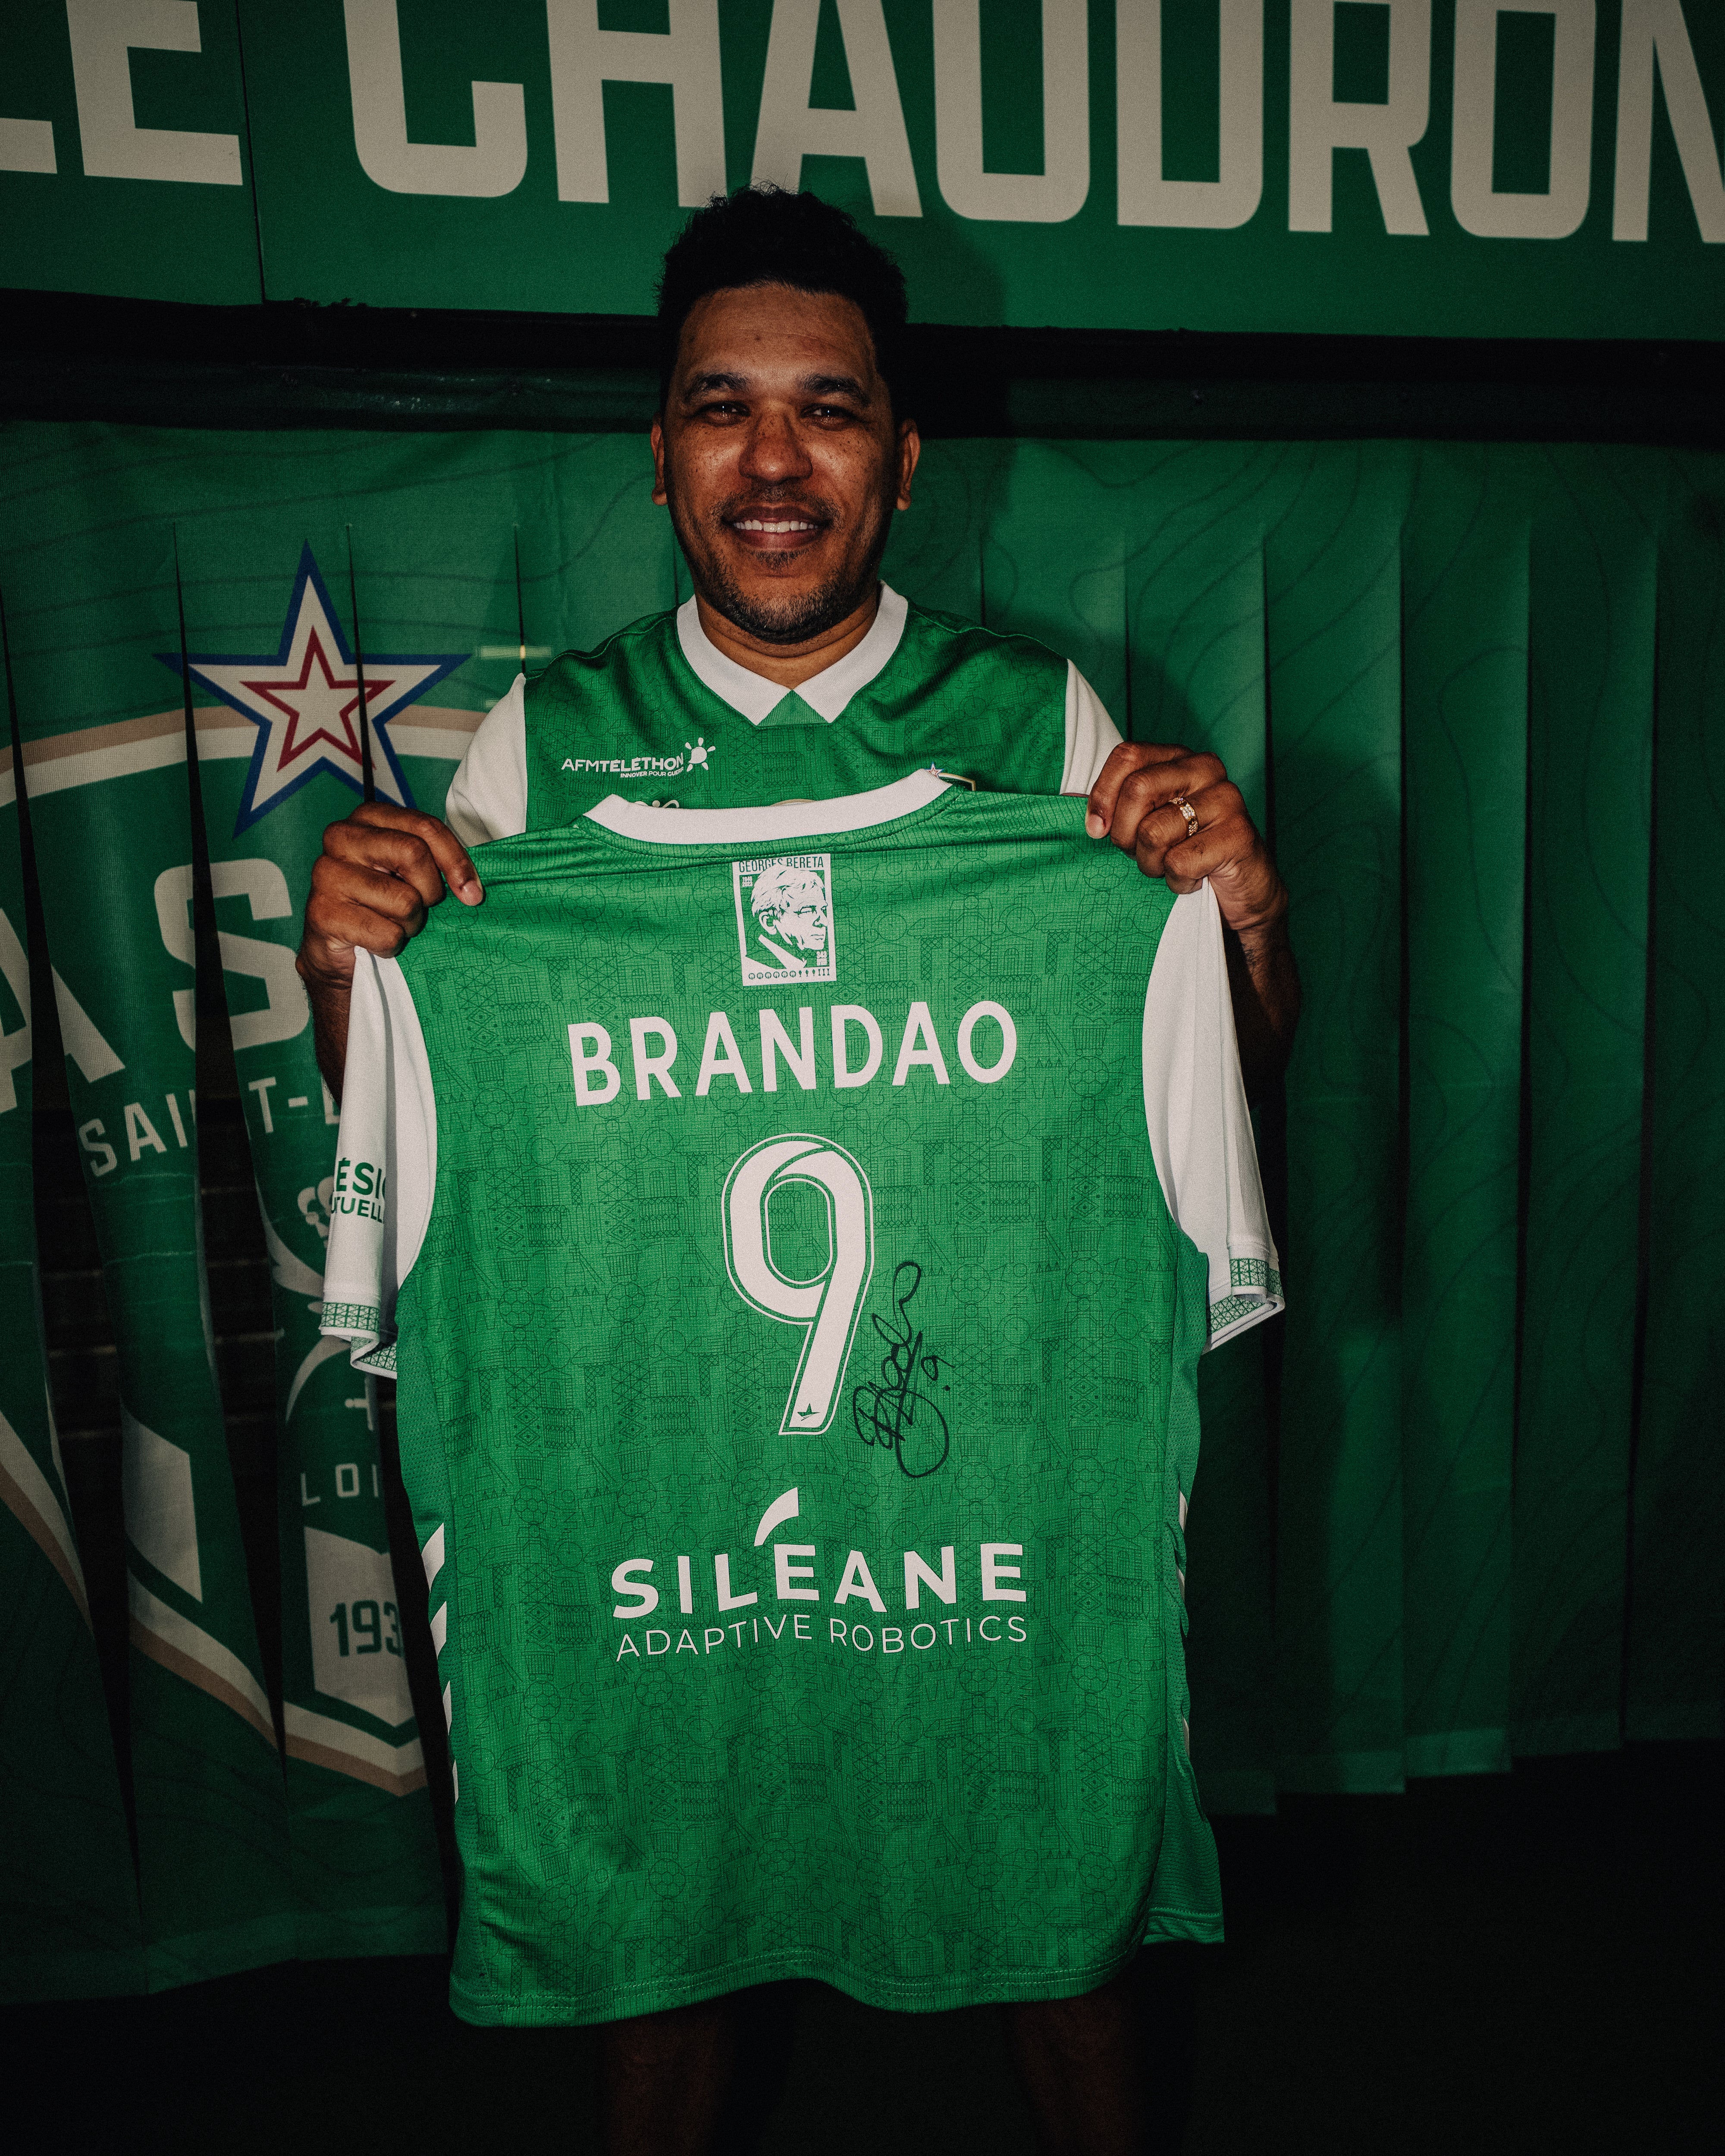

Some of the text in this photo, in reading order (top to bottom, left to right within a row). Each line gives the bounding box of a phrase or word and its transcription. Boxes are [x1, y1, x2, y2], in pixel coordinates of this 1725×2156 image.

[787, 856, 824, 868] BERETA
[567, 1000, 1017, 1106] BRANDAO
[721, 1132, 875, 1435] 9
[615, 1614, 1027, 1662] ADAPTIVE ROBOTICS
